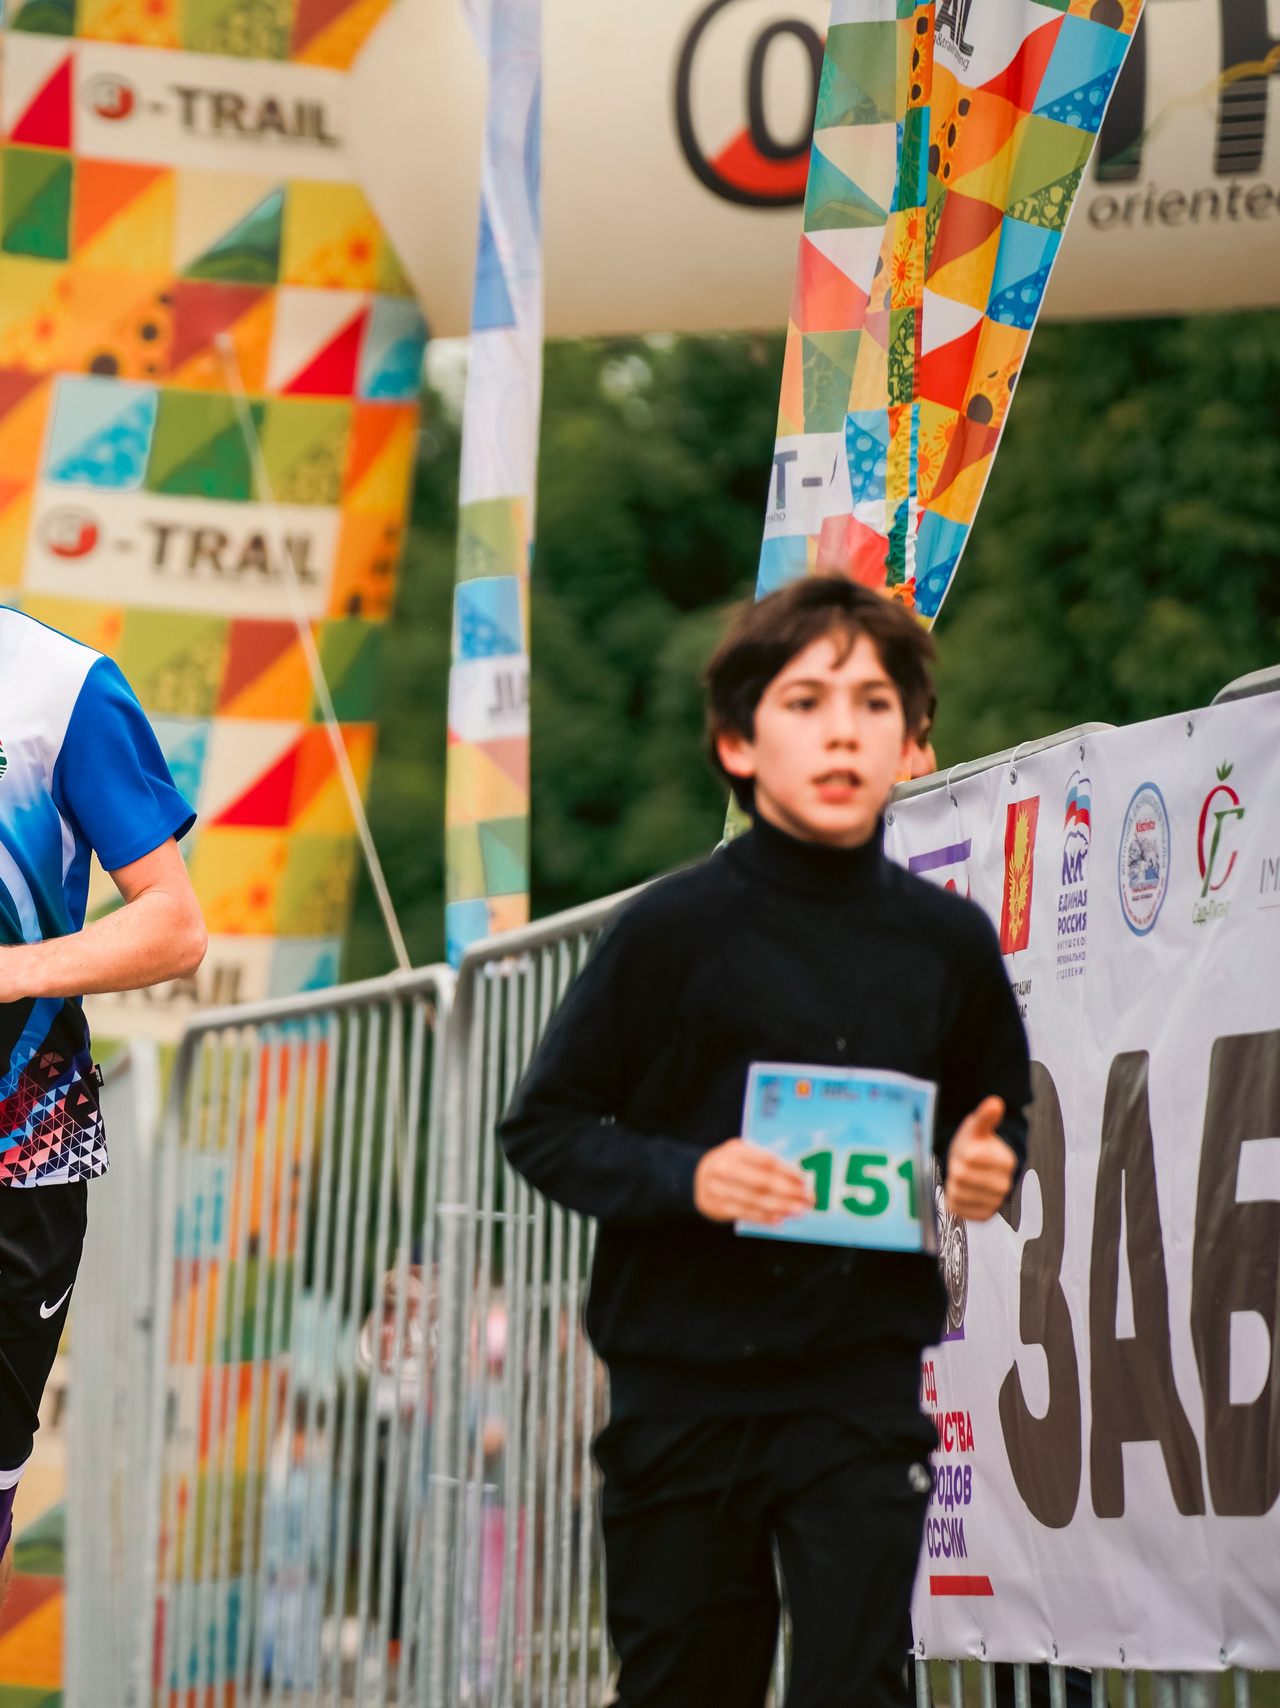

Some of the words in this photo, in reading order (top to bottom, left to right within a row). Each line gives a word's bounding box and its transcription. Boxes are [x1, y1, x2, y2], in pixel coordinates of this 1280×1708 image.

[1087, 181, 1280, 231] oriente
[1058, 889, 1087, 913] ЕДИНАЯ
[1057, 912, 1087, 936] РОССИЯ
[800, 1151, 918, 1219] 151
[927, 1517, 968, 1558] ОССИИ
